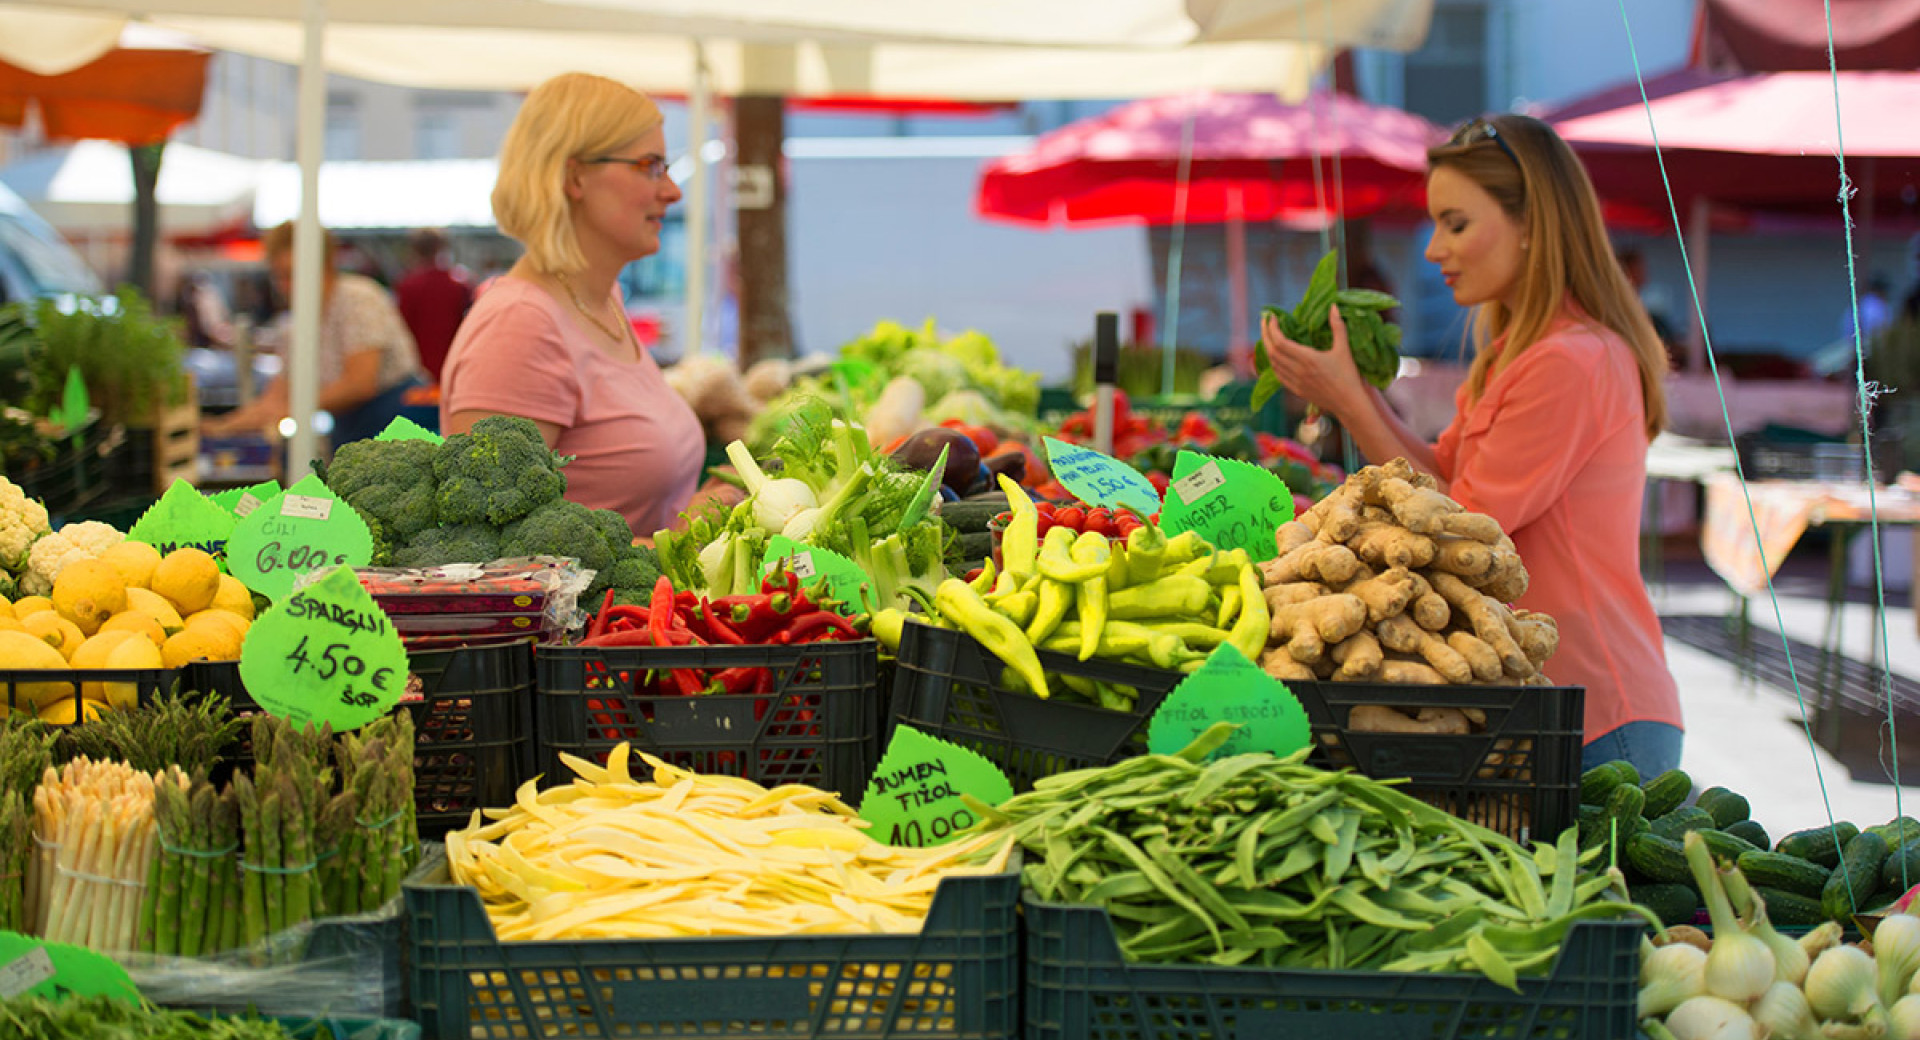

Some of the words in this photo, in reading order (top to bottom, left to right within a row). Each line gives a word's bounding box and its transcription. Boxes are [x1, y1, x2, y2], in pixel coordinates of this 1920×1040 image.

[260, 516, 297, 536] ČILI
[1174, 494, 1235, 532] INGVER
[256, 541, 328, 574] 6.00
[285, 635, 366, 680] 4.50
[370, 667, 395, 691] €
[895, 781, 961, 812] FIŽOL
[889, 809, 974, 848] 10.00
